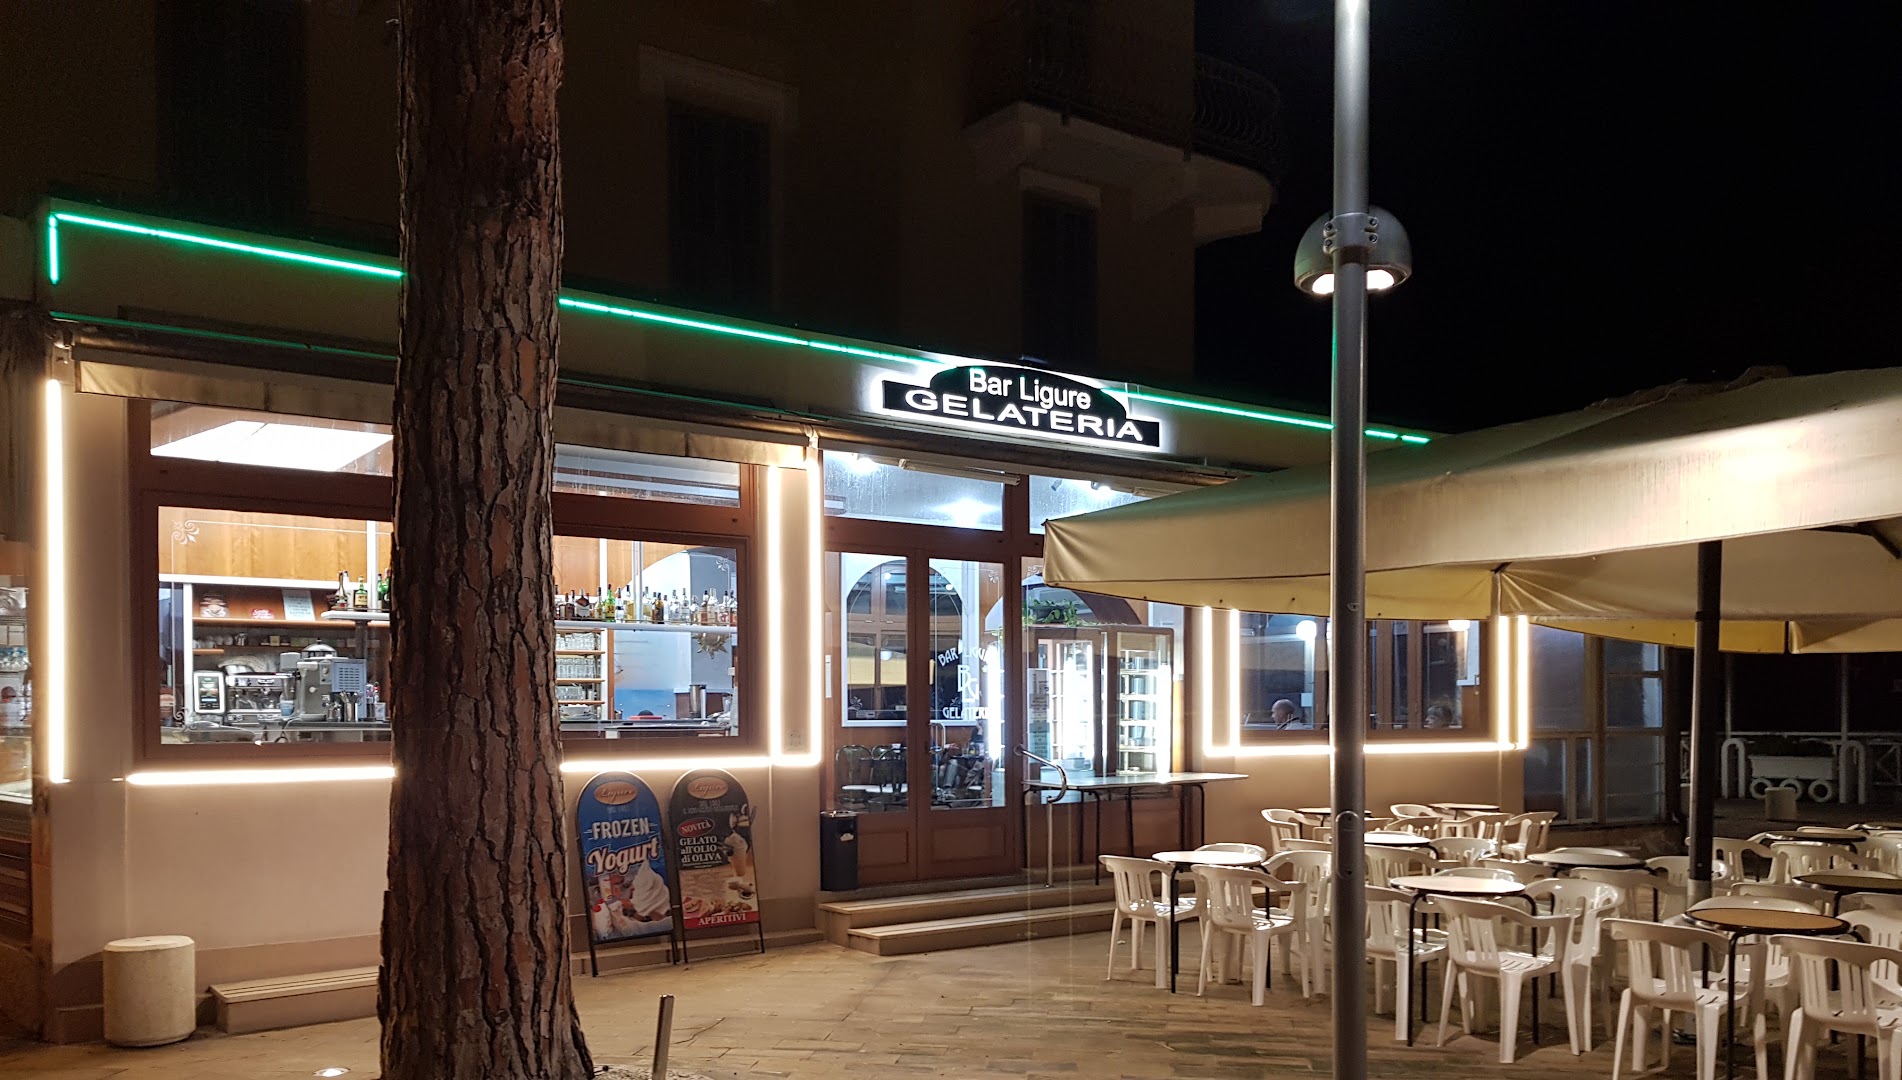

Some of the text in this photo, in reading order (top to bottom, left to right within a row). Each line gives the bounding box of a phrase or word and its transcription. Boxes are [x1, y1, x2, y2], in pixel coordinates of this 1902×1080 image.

[968, 367, 1092, 410] Bar Ligure
[905, 388, 1144, 441] GELATERIA
[938, 647, 959, 667] BAR
[592, 817, 650, 840] FROZEN
[681, 819, 712, 834] NOVITÀ
[679, 835, 718, 846] GELATO
[586, 836, 659, 876] Yogurt
[680, 844, 718, 855] all'OLIO
[681, 852, 722, 863] di OLIVA
[698, 912, 747, 926] APERITIVI
